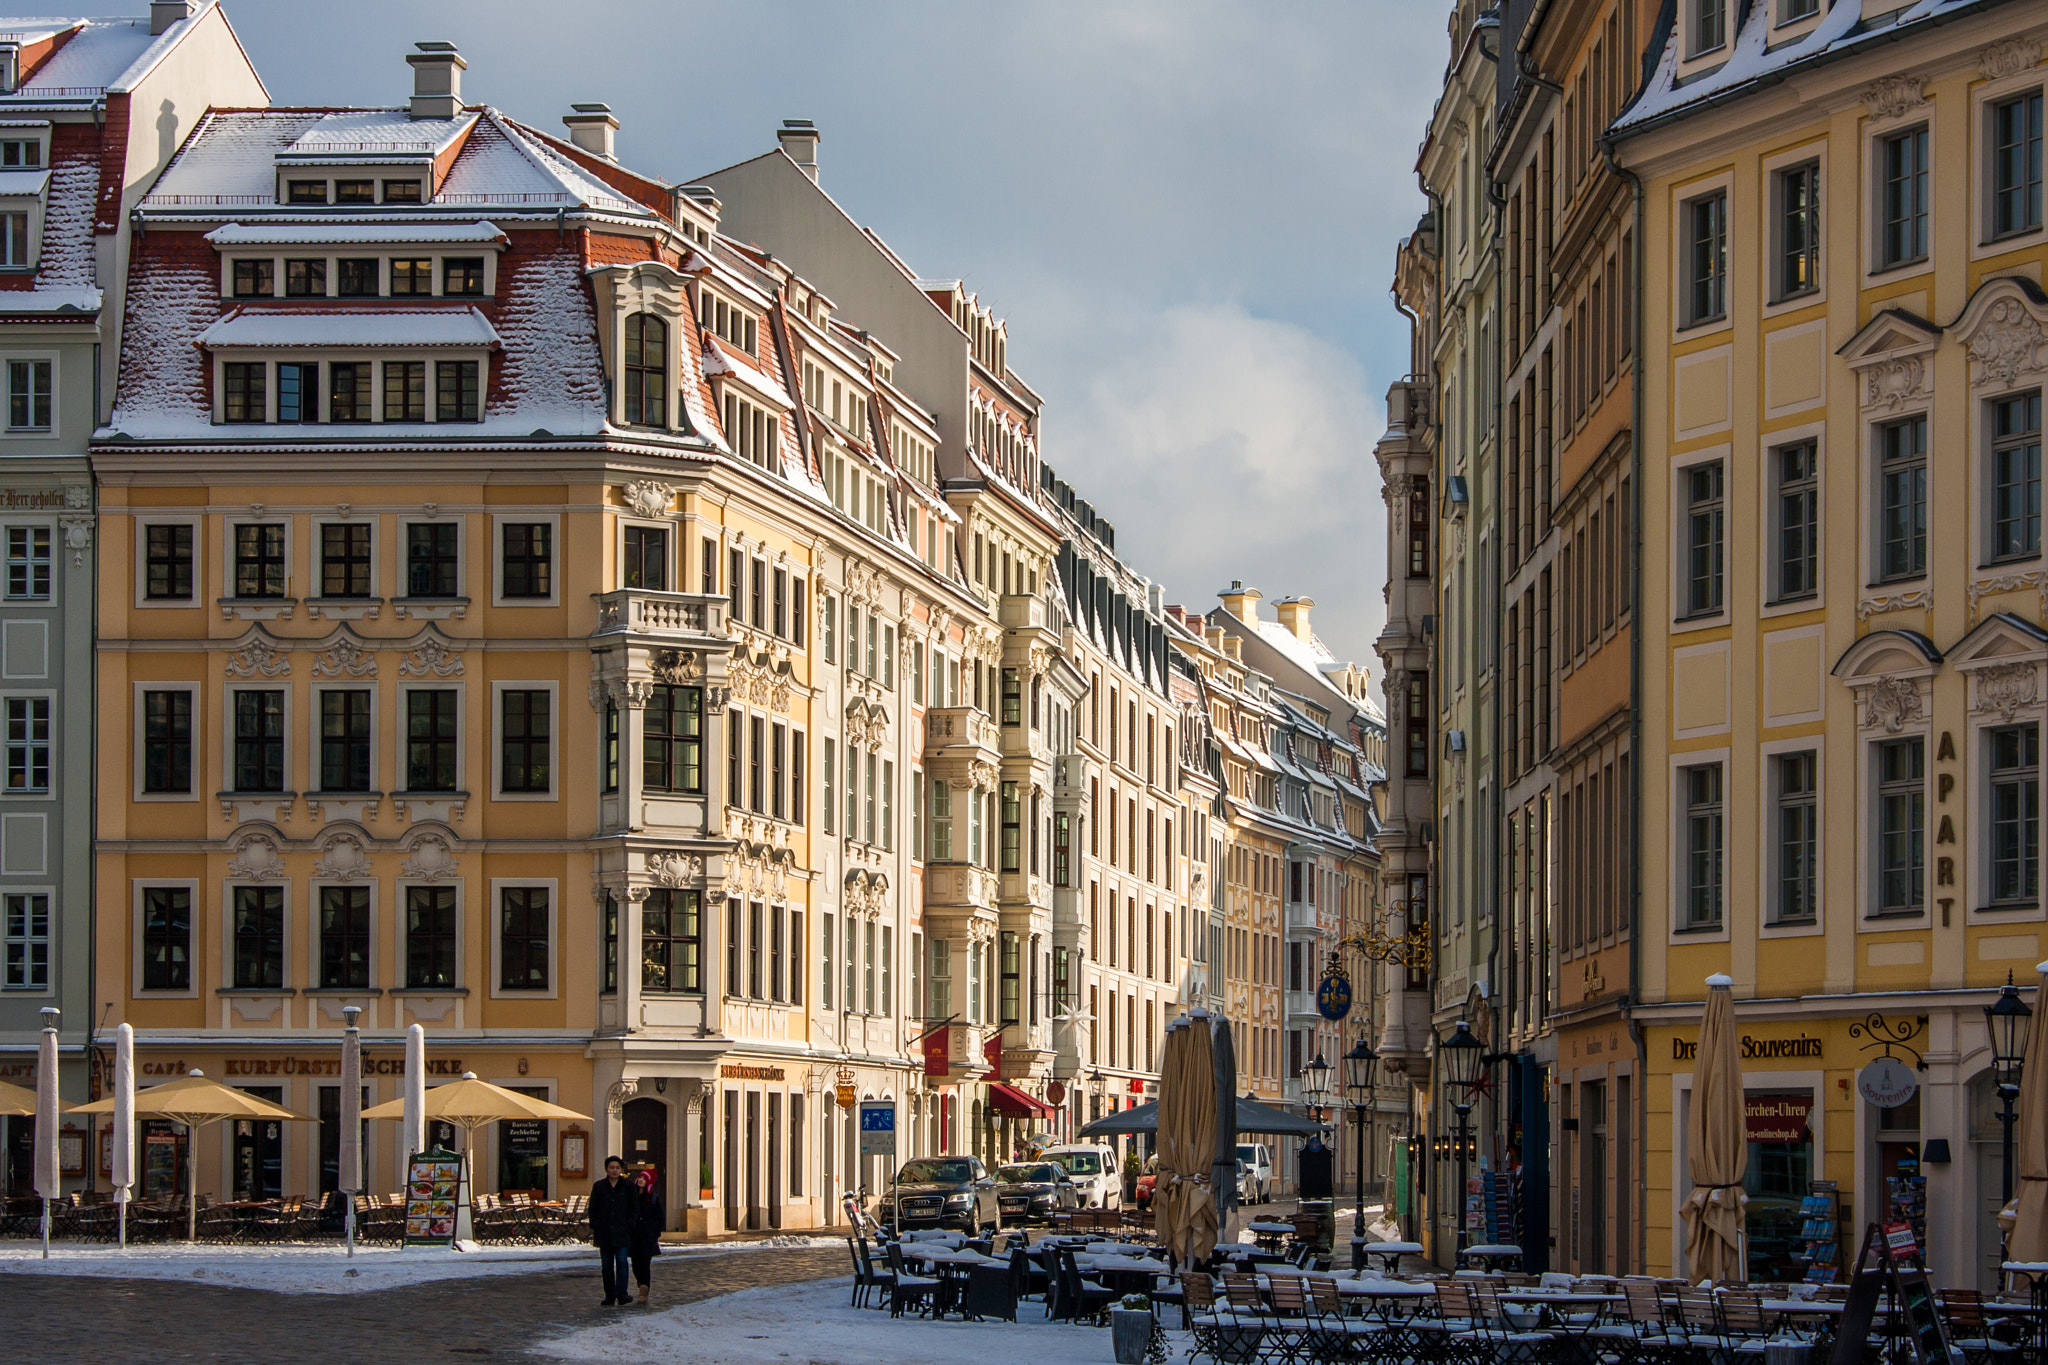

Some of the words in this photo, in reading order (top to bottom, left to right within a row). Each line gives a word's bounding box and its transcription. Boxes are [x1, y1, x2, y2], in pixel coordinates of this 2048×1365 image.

[1937, 731, 1956, 927] APART
[1741, 1032, 1822, 1058] Souvenirs
[142, 1060, 186, 1075] CAFÉ
[225, 1057, 462, 1075] KURFÜRSTSCHNKE
[1863, 1083, 1913, 1103] Souvenirs
[1746, 1128, 1798, 1141] en-onlineshop.de
